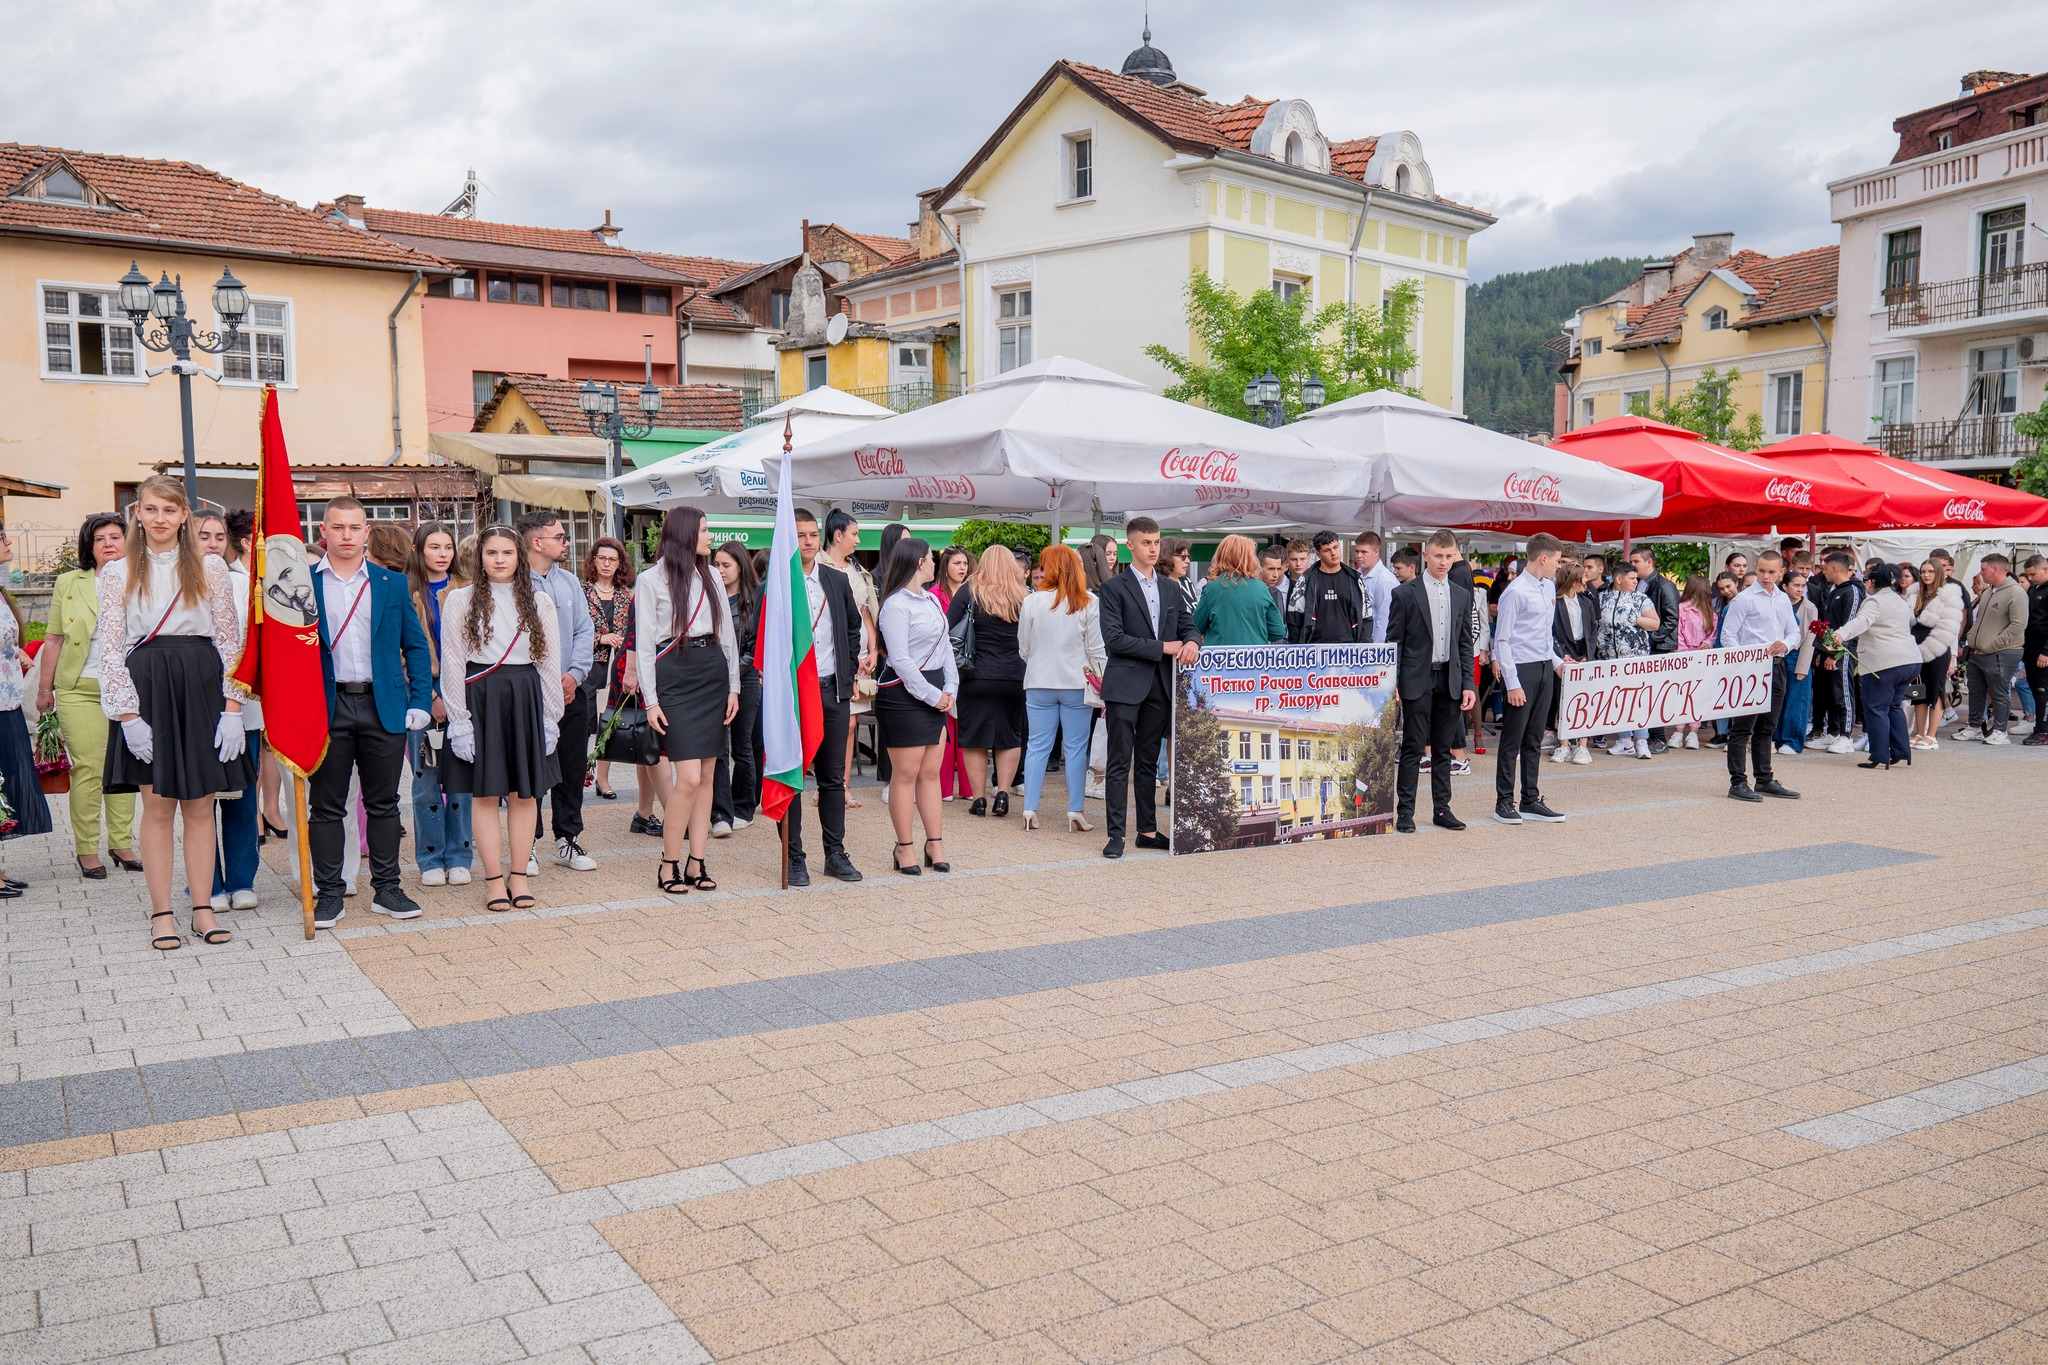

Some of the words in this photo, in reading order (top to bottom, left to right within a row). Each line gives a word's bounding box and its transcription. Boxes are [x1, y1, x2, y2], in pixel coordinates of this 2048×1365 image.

[854, 447, 906, 476] Coca-Cola
[1160, 447, 1240, 483] Coca-Cola
[1503, 472, 1562, 503] Coca-Cola
[1765, 477, 1812, 506] Coca-Cola
[1974, 473, 2003, 486] BET
[1943, 498, 1987, 521] Coca-Cola
[1180, 647, 1316, 671] ОФЕСИОНАЛНА
[1321, 646, 1396, 668] ГИМНАЗИЯ
[1569, 667, 1585, 682] ПГ
[1610, 664, 1619, 677] Р.
[1706, 653, 1719, 667] ГР.
[1724, 648, 1769, 665] ЯКОРУДА
[1260, 674, 1303, 691] Рачов
[1255, 696, 1274, 713] гр.
[1278, 692, 1339, 710] Якоруда
[1566, 679, 1703, 731] ВИПУСК
[1712, 671, 1772, 711] 2025
